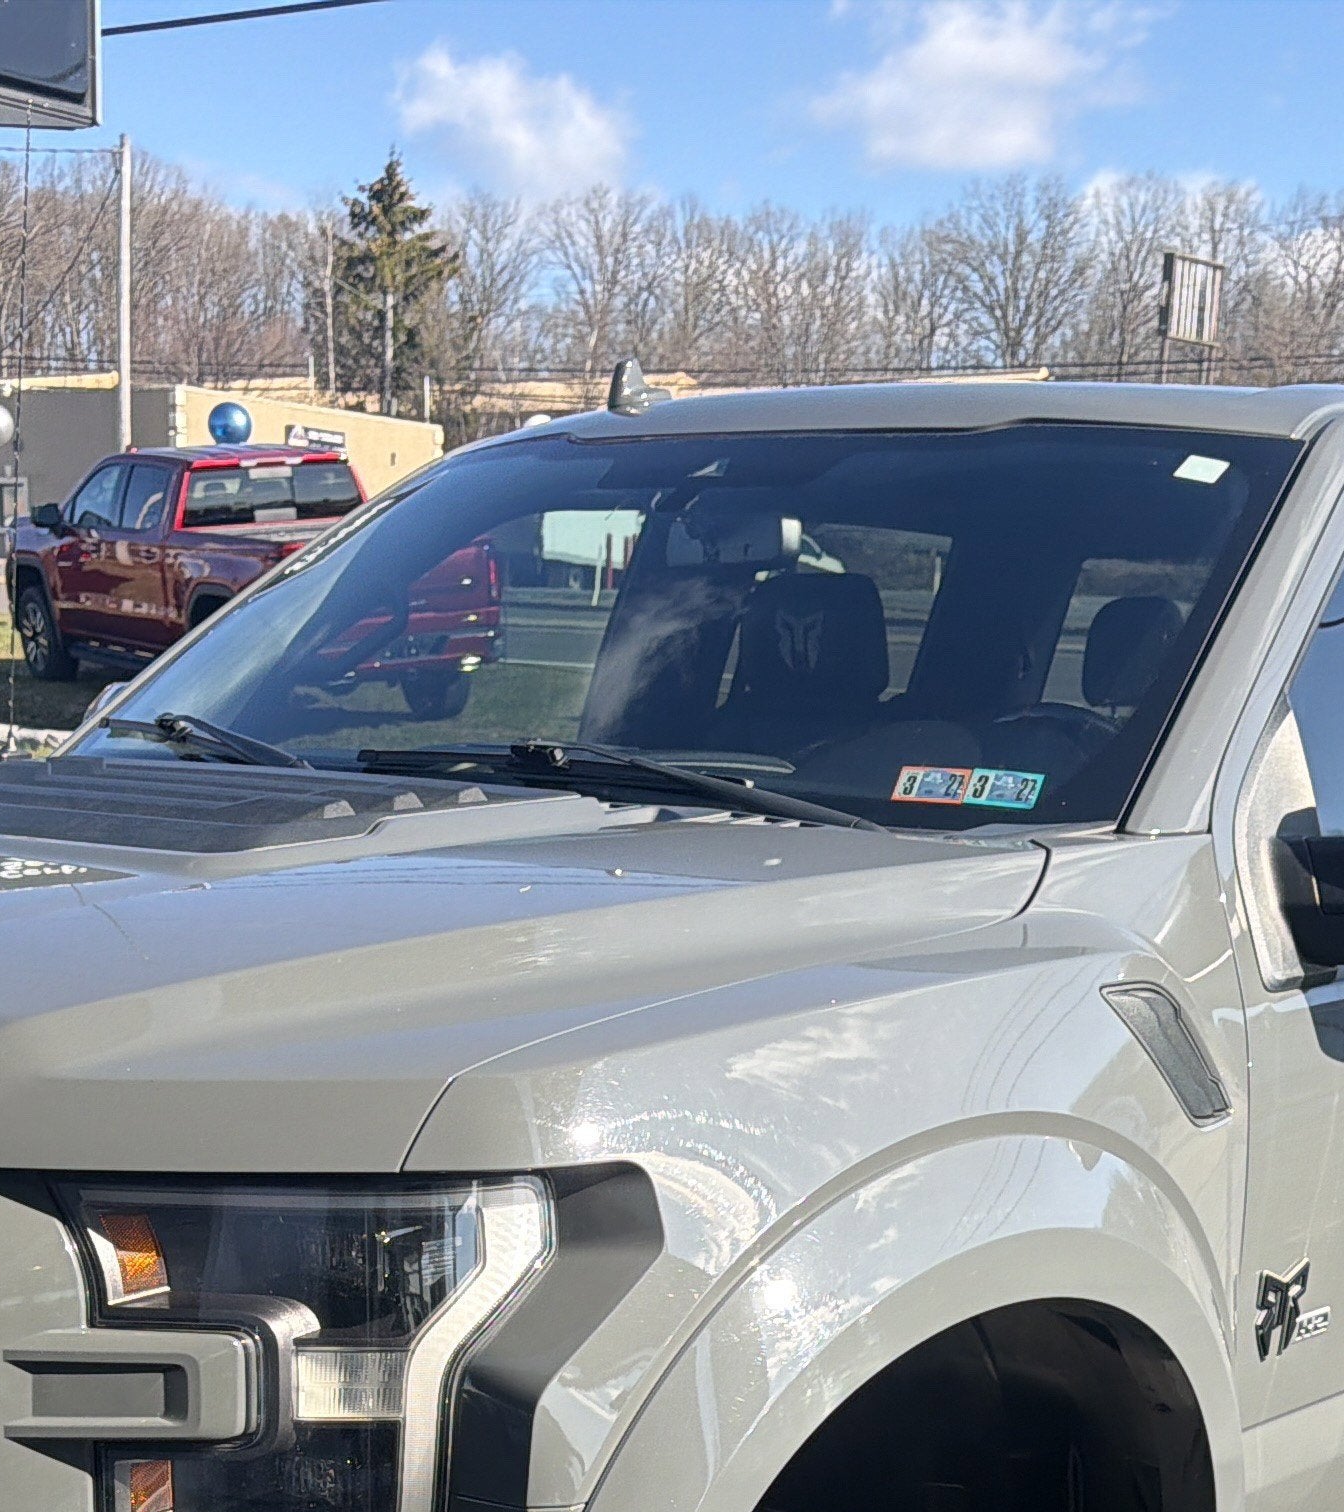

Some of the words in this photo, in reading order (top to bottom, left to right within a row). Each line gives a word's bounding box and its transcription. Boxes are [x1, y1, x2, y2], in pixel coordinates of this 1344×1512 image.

[903, 775, 918, 796] 3
[943, 773, 966, 799] 27
[972, 775, 990, 798] 3
[1015, 778, 1038, 802] 27
